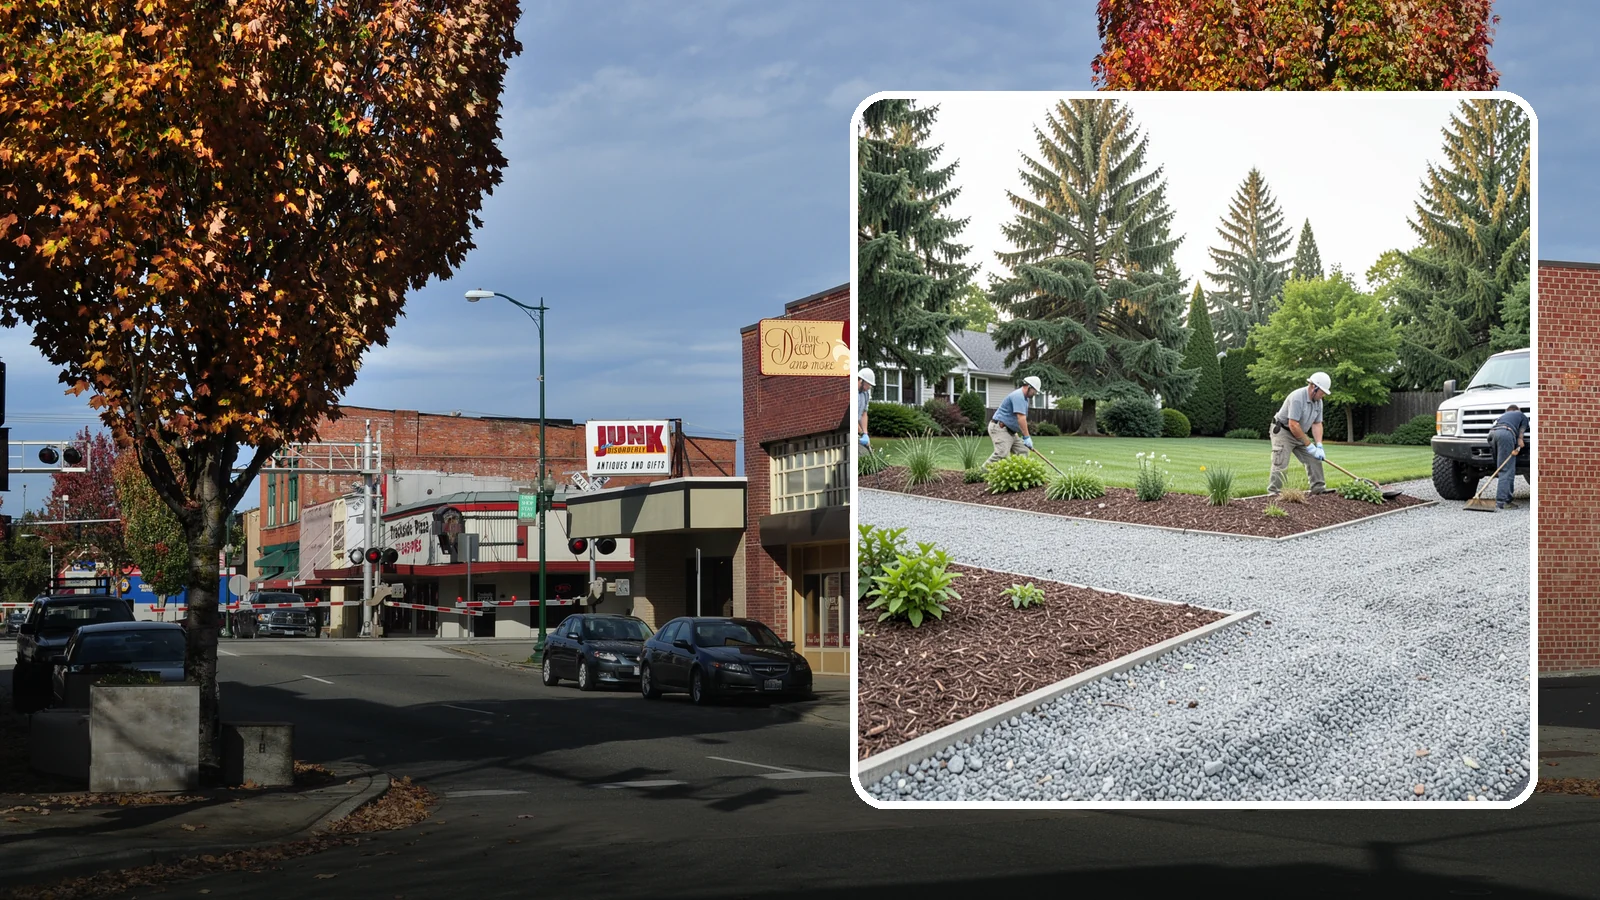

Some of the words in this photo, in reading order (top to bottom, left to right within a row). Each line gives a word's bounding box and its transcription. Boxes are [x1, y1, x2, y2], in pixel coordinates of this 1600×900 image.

[595, 425, 666, 457] JUNK
[607, 446, 646, 454] DISORDERLY
[597, 461, 628, 470] ANTIQUES
[631, 461, 643, 469] AND
[647, 460, 665, 469] GIFTS
[352, 498, 364, 510] CRO
[390, 523, 413, 539] Trackside
[414, 520, 429, 534] Pizza
